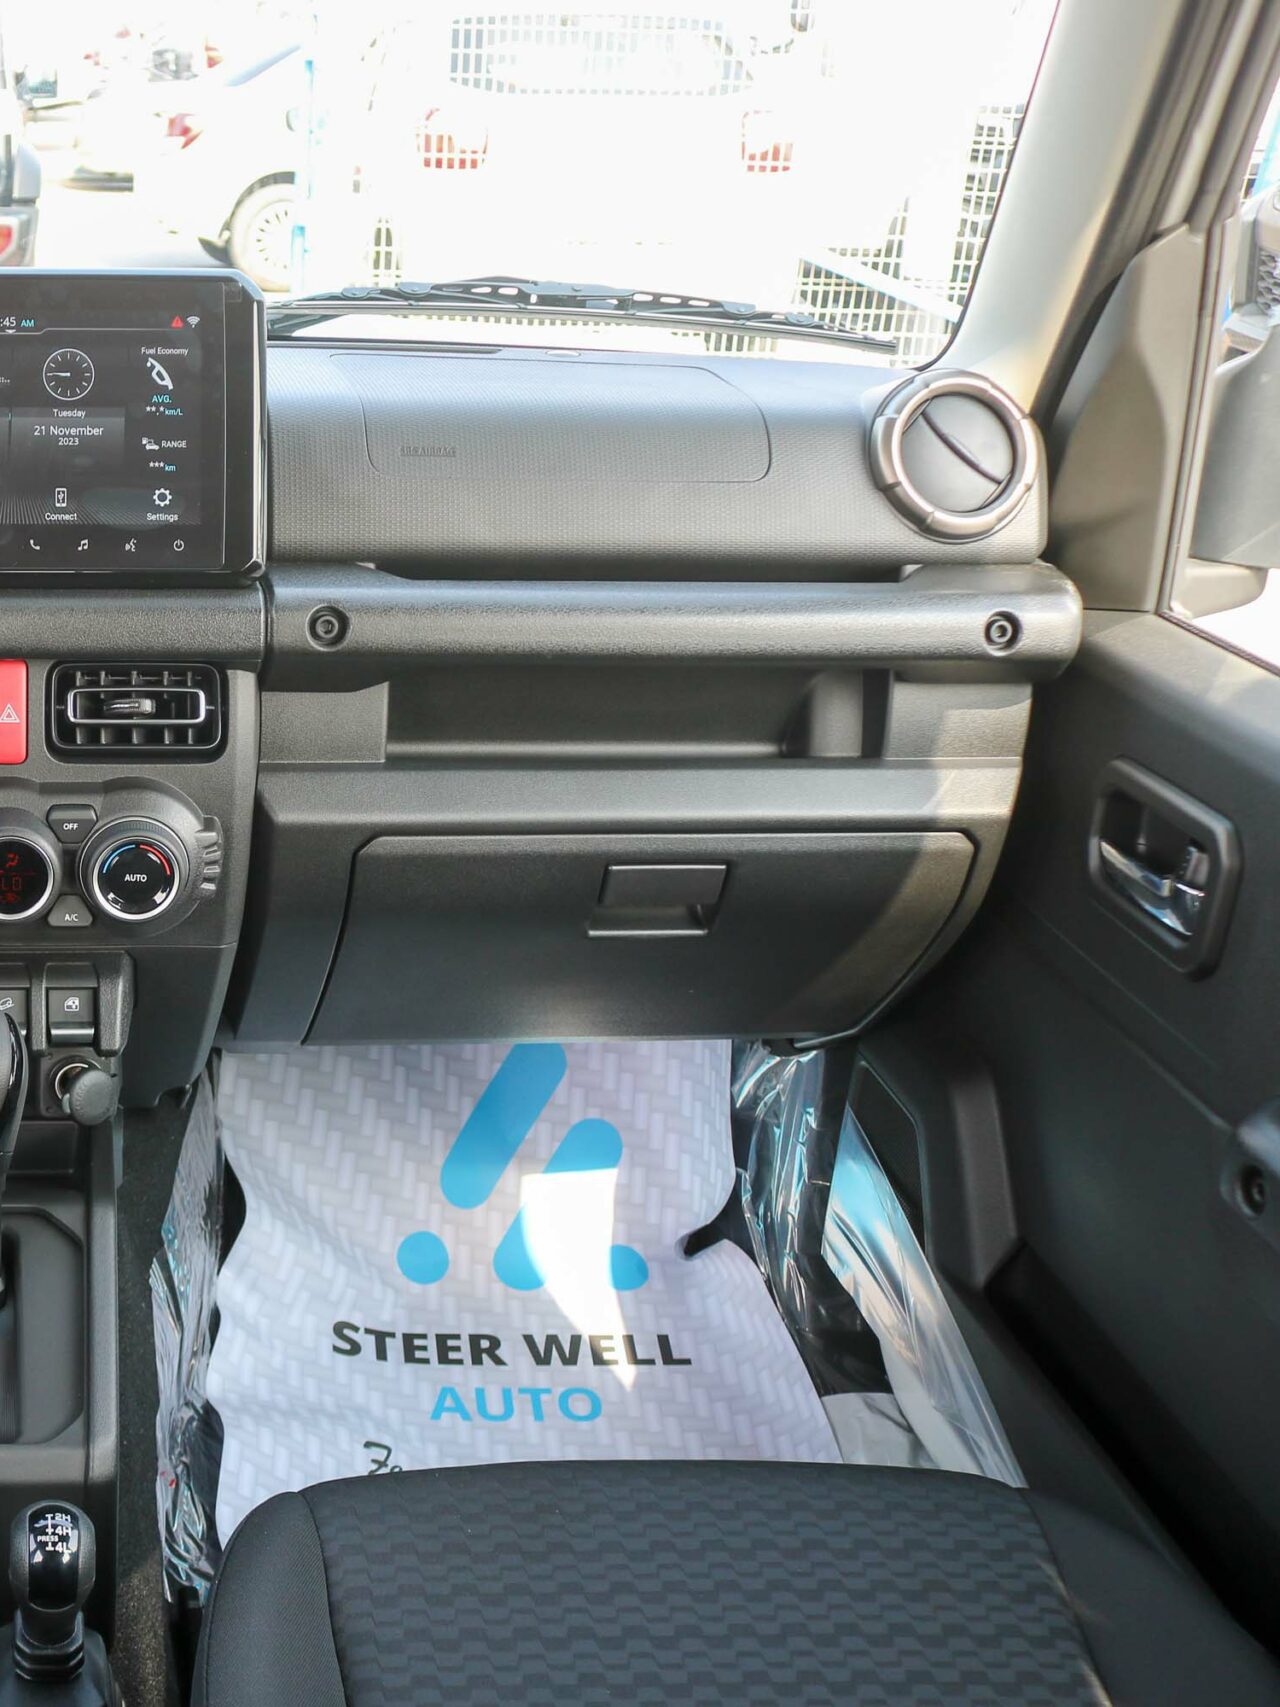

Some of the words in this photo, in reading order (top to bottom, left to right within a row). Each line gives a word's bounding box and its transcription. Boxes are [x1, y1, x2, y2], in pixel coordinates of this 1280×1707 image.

[20, 319, 35, 327] AM
[141, 347, 156, 355] Fuel
[157, 347, 189, 356] Economy
[152, 395, 172, 403] AVG.
[53, 409, 86, 419] Tuesday
[34, 425, 46, 436] 21
[49, 425, 104, 436] November
[58, 437, 79, 446] 2023
[161, 440, 187, 448] RANGE
[165, 464, 176, 472] km
[45, 512, 77, 521] Connect
[147, 512, 178, 522] Settings
[63, 822, 78, 831] OFF
[124, 873, 148, 883] AUTO
[64, 913, 79, 923] A/C
[332, 1321, 508, 1367] STEER
[522, 1333, 693, 1367] WELL
[430, 1386, 603, 1423] AUTO
[55, 1512, 71, 1523] 2H
[55, 1525, 72, 1536] 4H
[37, 1534, 59, 1543] PRESS
[55, 1541, 72, 1554] 4L
